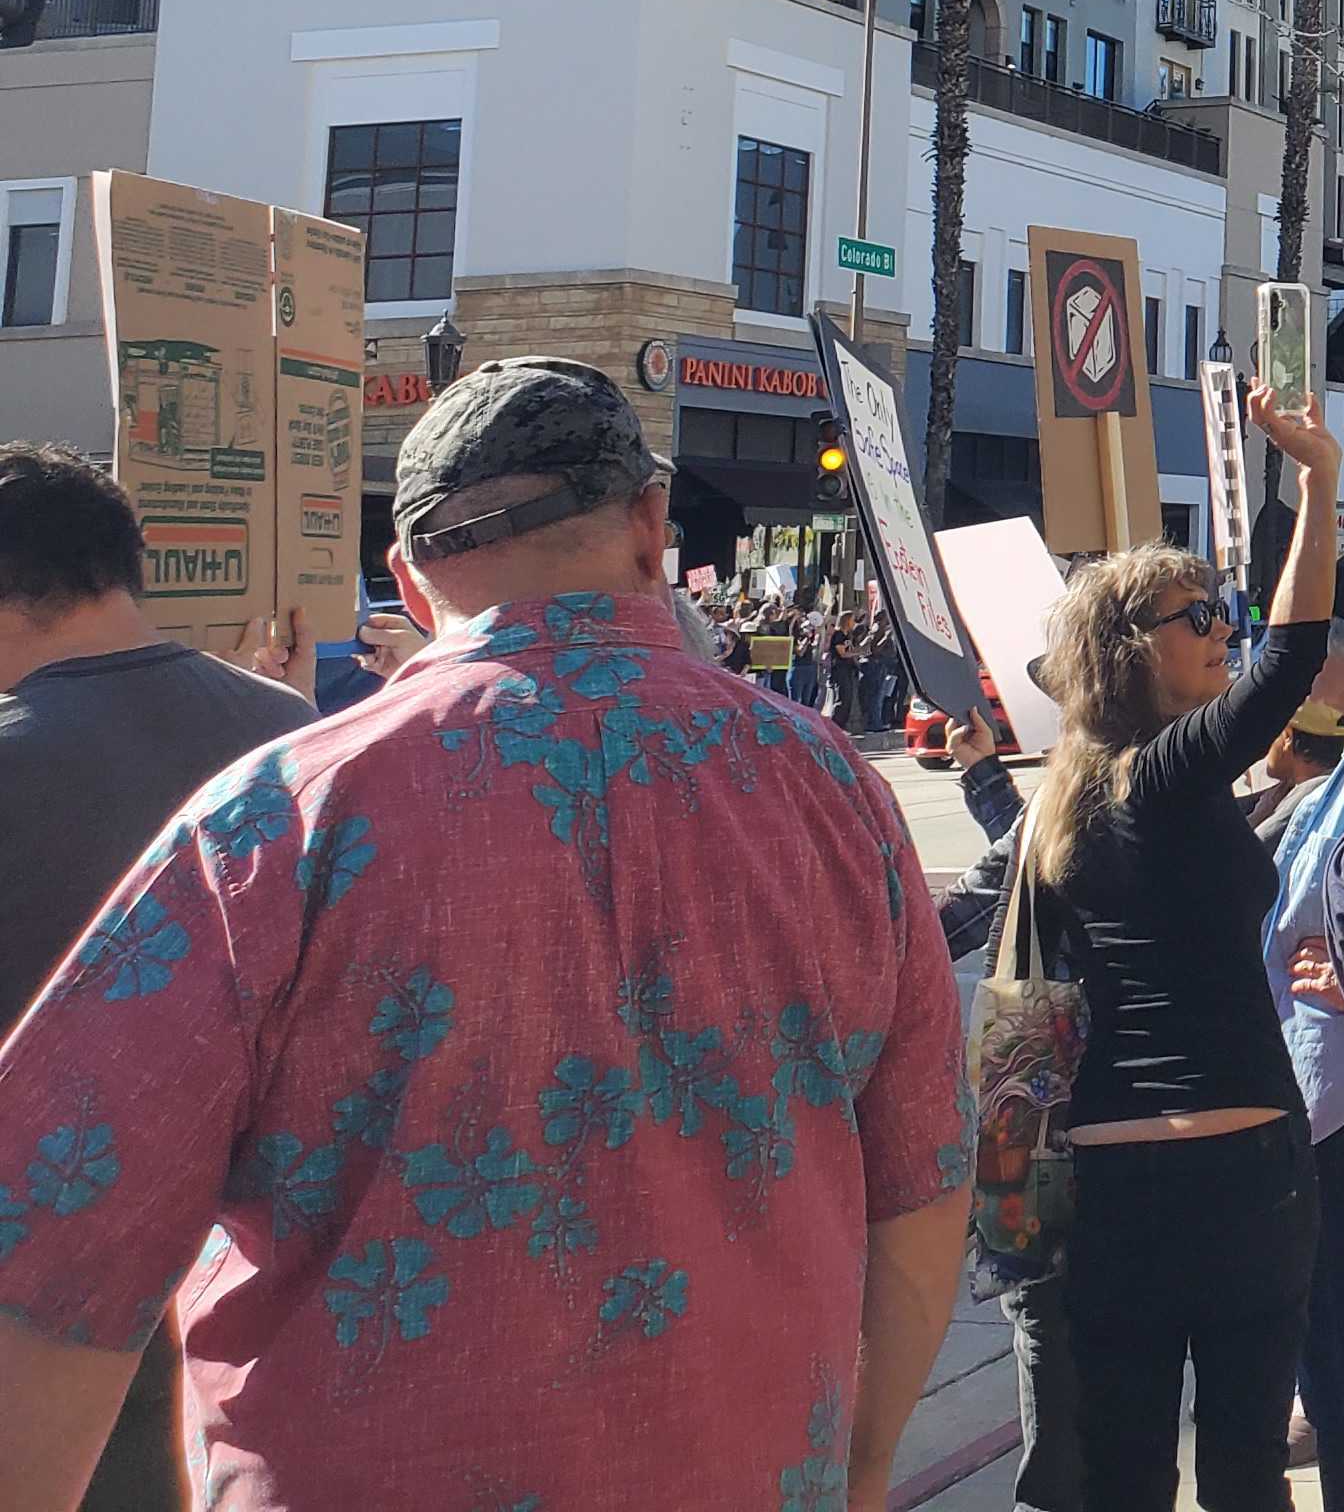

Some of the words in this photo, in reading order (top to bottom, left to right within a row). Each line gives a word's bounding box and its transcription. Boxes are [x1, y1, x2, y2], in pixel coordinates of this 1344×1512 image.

[841, 244, 880, 268] Colorado
[884, 252, 893, 271] Bl
[684, 357, 753, 391] PANINI
[758, 366, 817, 398] KABOB
[144, 549, 242, 583] U-HAUL
